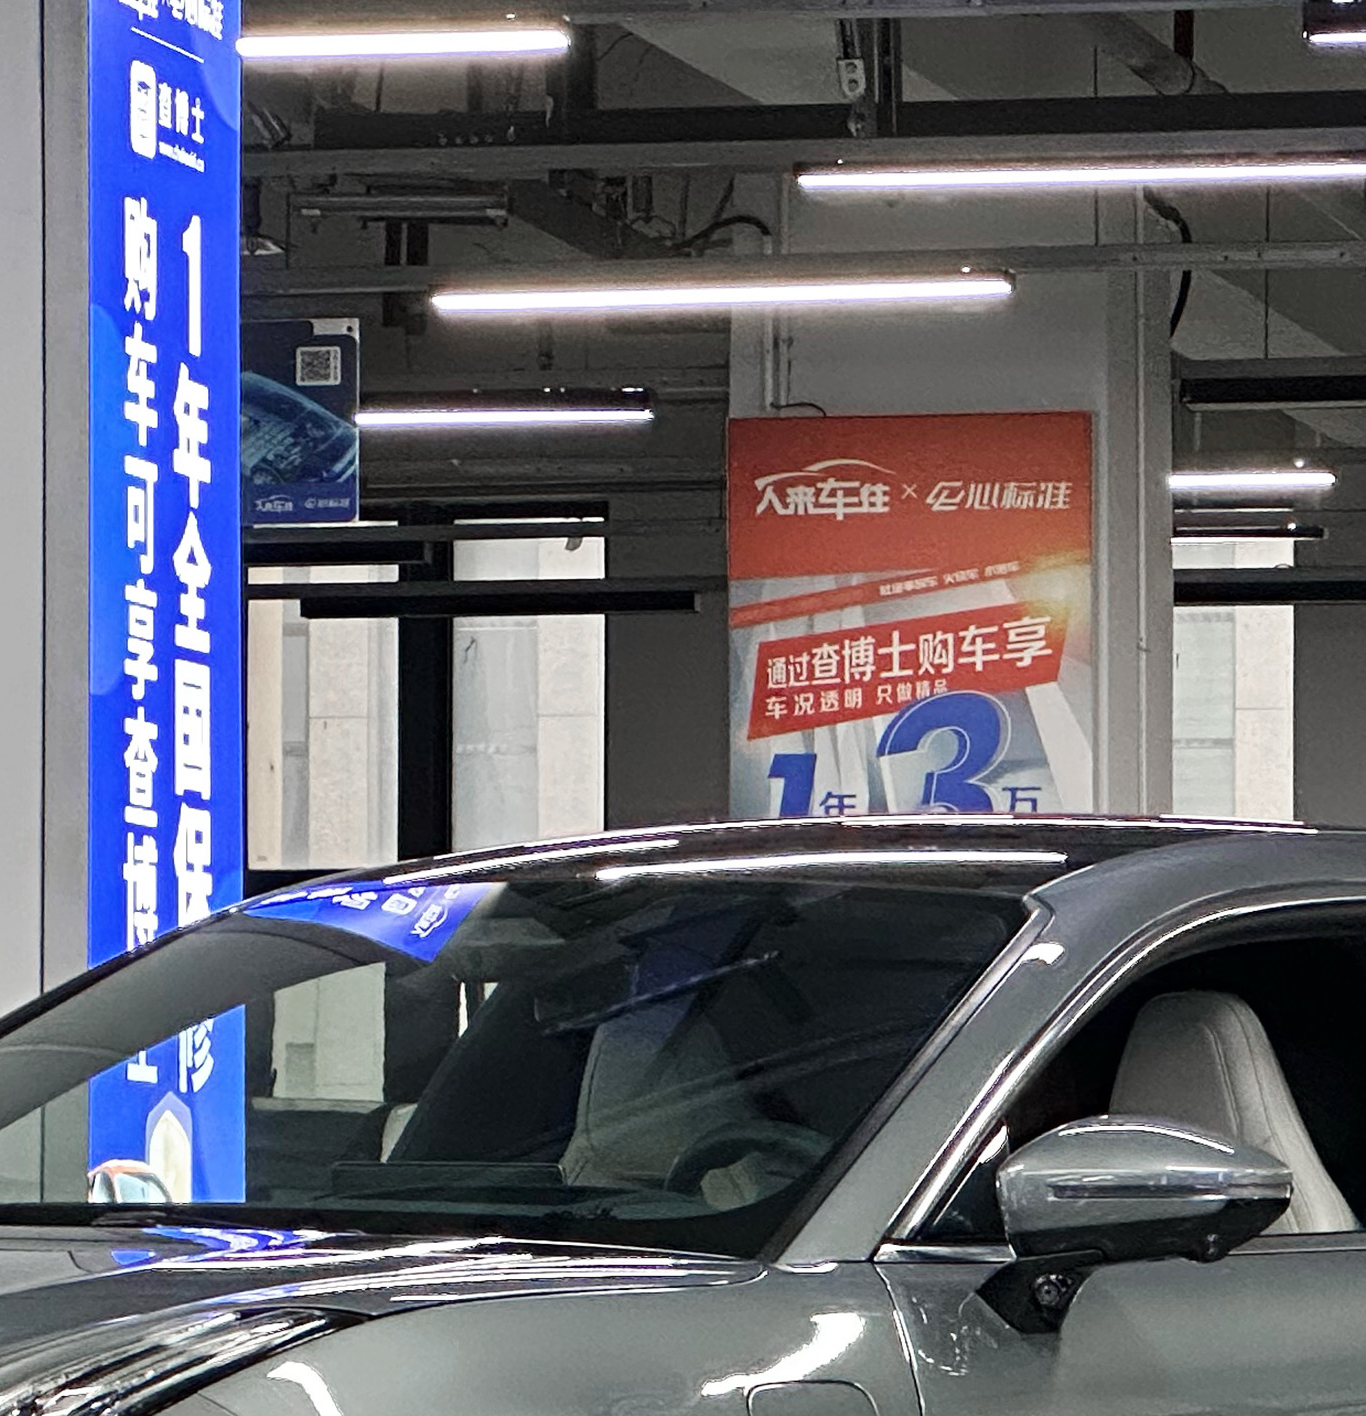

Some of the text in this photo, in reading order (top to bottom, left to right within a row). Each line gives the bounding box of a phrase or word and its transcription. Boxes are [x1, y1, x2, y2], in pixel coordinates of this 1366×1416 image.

[767, 615, 1053, 690] 通过查博士购车享
[765, 689, 863, 720] 车况透明
